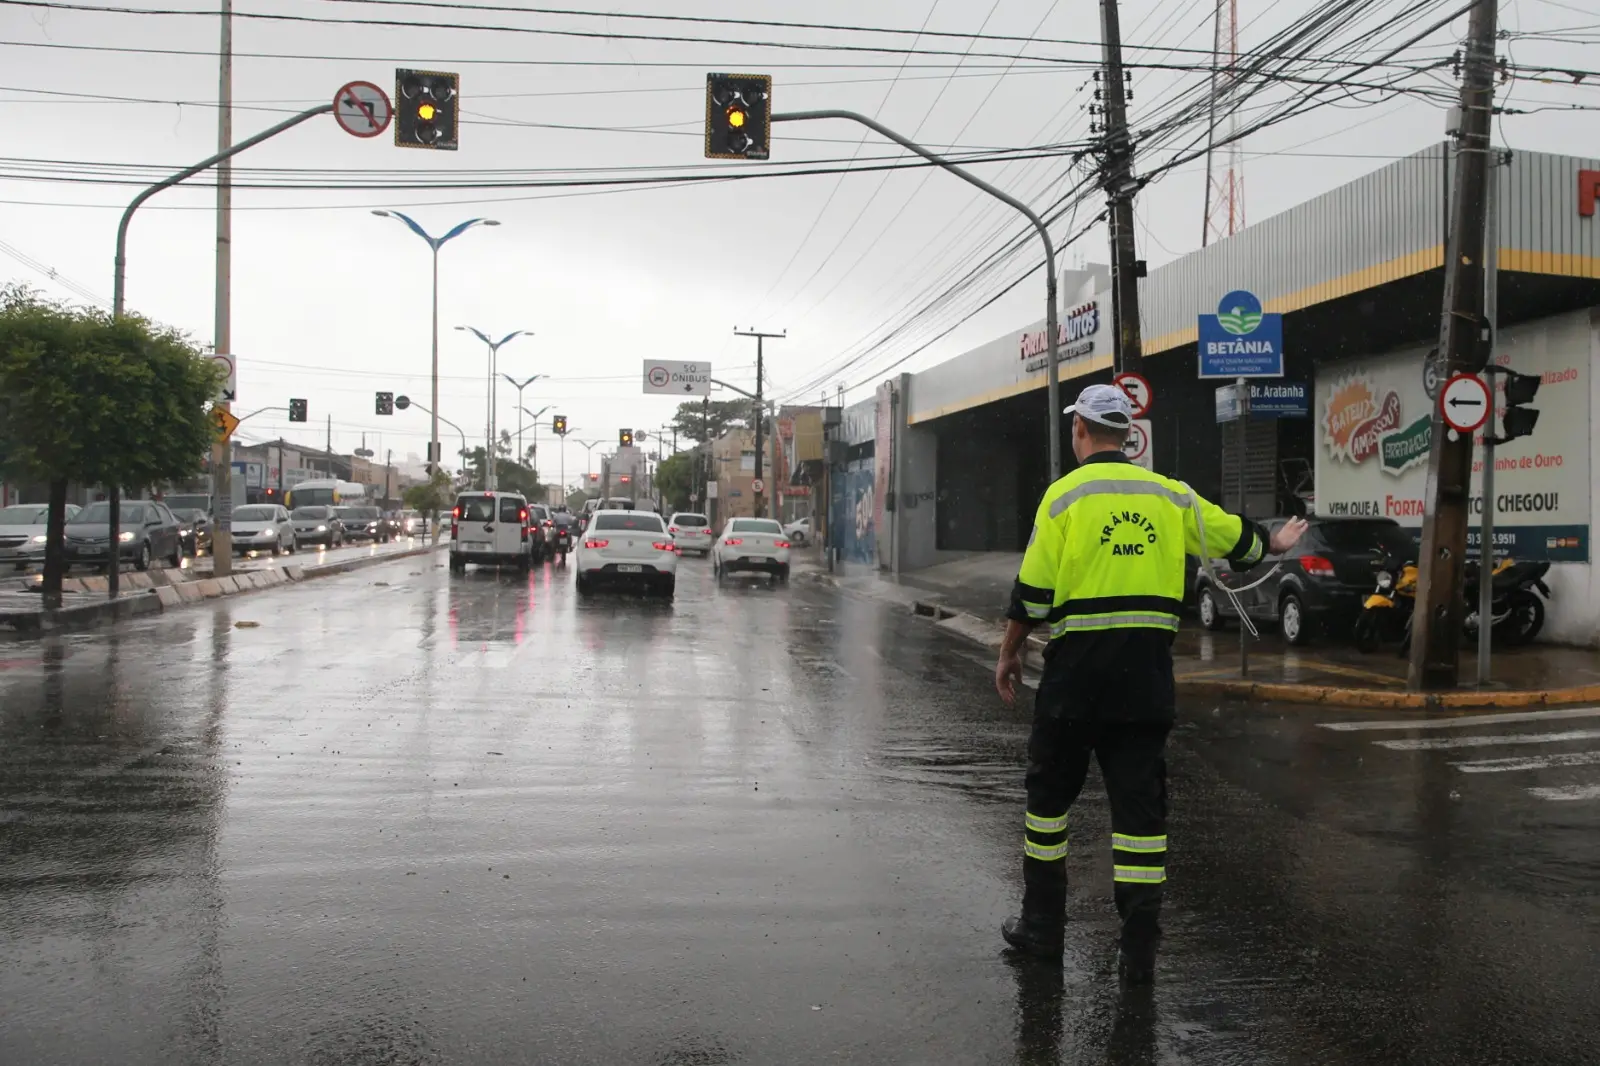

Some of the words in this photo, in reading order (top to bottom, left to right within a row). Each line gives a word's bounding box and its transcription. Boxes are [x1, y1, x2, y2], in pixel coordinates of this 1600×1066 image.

[1207, 338, 1273, 355] BETÂNIA
[672, 372, 708, 383] ÔNIBUS
[1251, 386, 1262, 398] Br.
[1264, 385, 1304, 398] Aratanha
[1519, 456, 1532, 468] de
[1535, 453, 1563, 467] Ouro
[1329, 502, 1349, 515] VEM
[1373, 500, 1379, 515] A
[1497, 493, 1558, 512] CHEGOU!
[1101, 511, 1156, 545] TRÂNSITO
[1112, 544, 1144, 556] AMC
